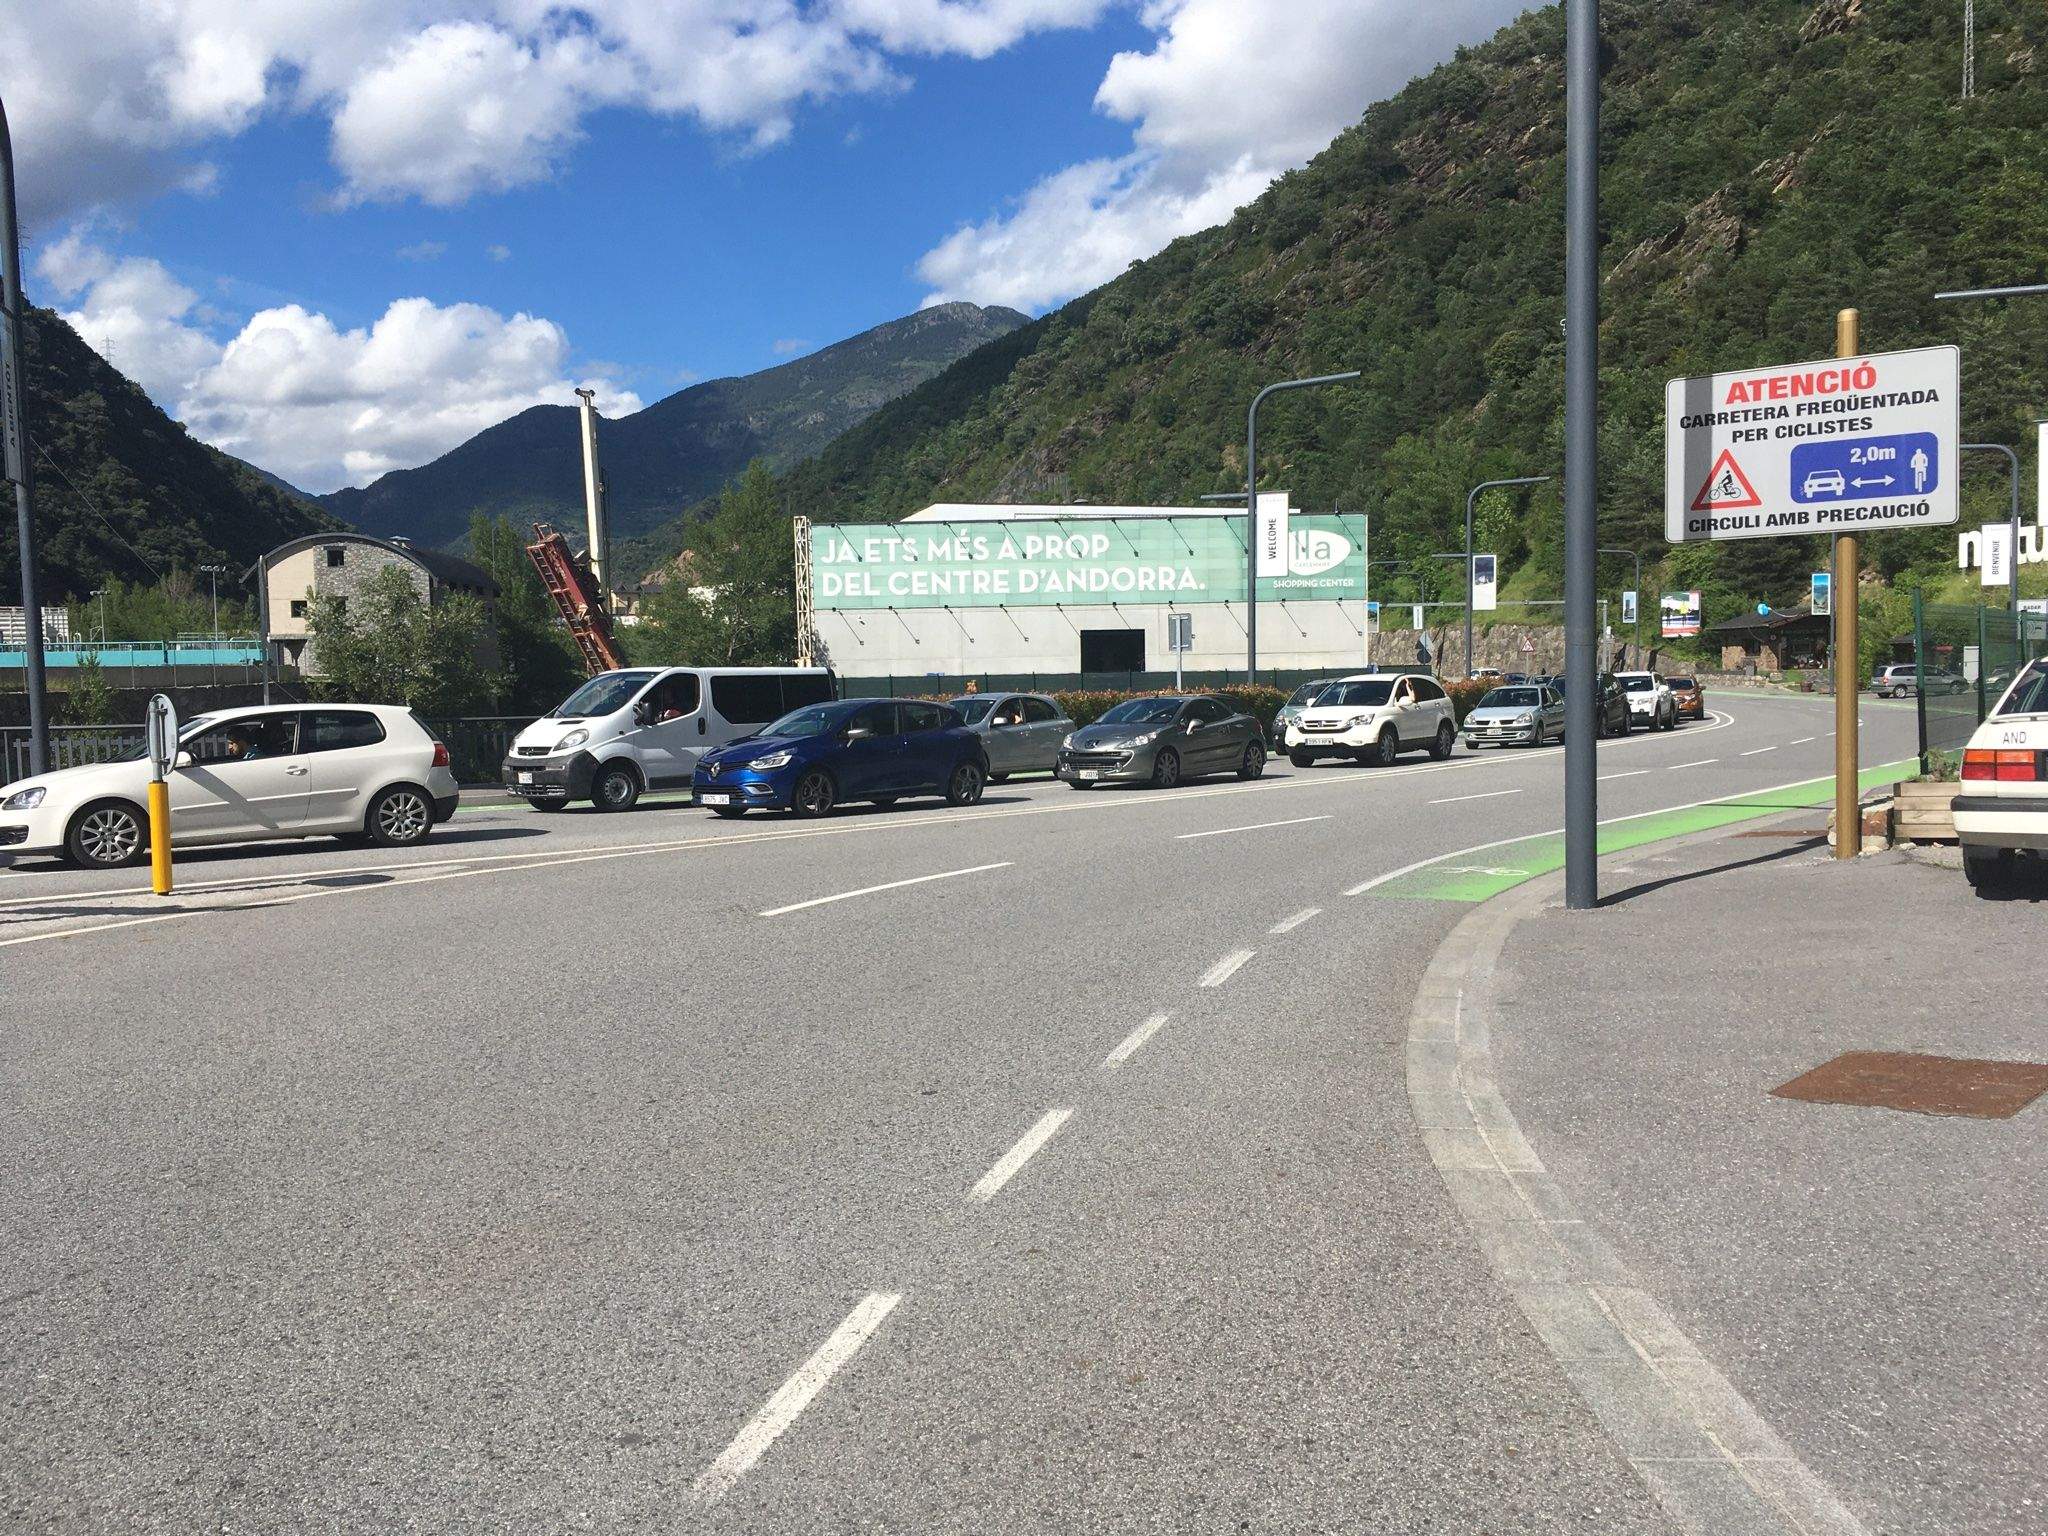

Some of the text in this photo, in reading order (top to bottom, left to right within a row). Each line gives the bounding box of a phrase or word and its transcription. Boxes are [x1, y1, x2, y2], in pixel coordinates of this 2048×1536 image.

[1726, 361, 1877, 404] ATENCIÓ
[1680, 389, 1940, 429] CARRETERA FREQÜENTADA
[1732, 416, 1873, 443] PER CICLISTES
[1850, 446, 1896, 465] 2,0m
[1688, 499, 1930, 532] CIRCULI AMB PRECAUCIÓ
[821, 528, 1110, 563] JA ETS MÉS A PROP
[1268, 518, 1277, 560] WELCOME
[1992, 540, 2001, 575] BIENVENUE
[822, 566, 1206, 597] DEL CENTRE D'ANDORRA.
[1273, 578, 1354, 589] SHOPPING CENTER
[2003, 731, 2027, 745] AND
